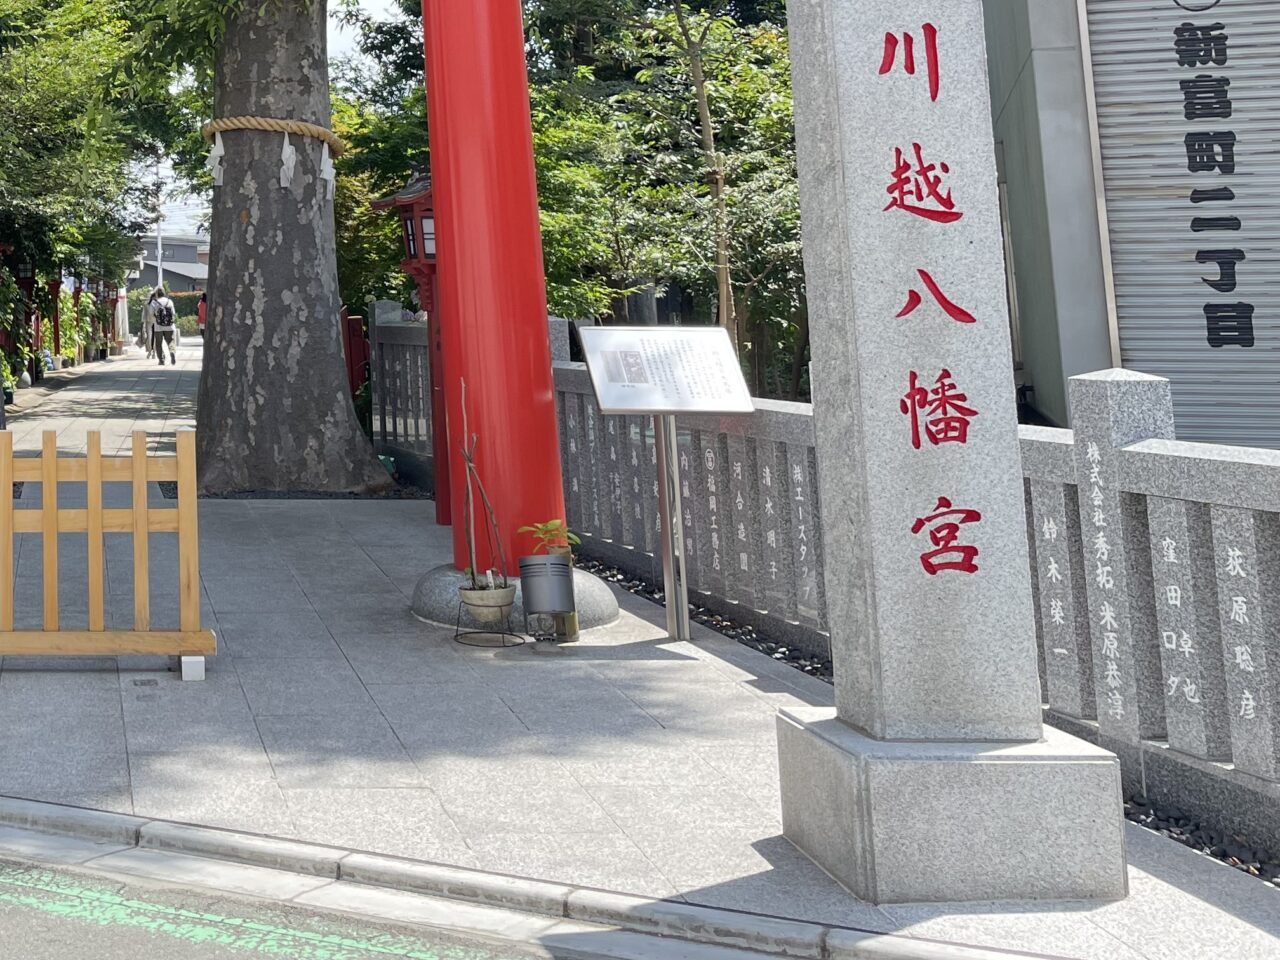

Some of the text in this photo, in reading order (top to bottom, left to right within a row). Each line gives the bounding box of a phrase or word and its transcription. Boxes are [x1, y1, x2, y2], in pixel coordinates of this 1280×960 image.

[878, 22, 979, 576] 川越八幡宮
[1174, 22, 1254, 348] 新富町二丁目
